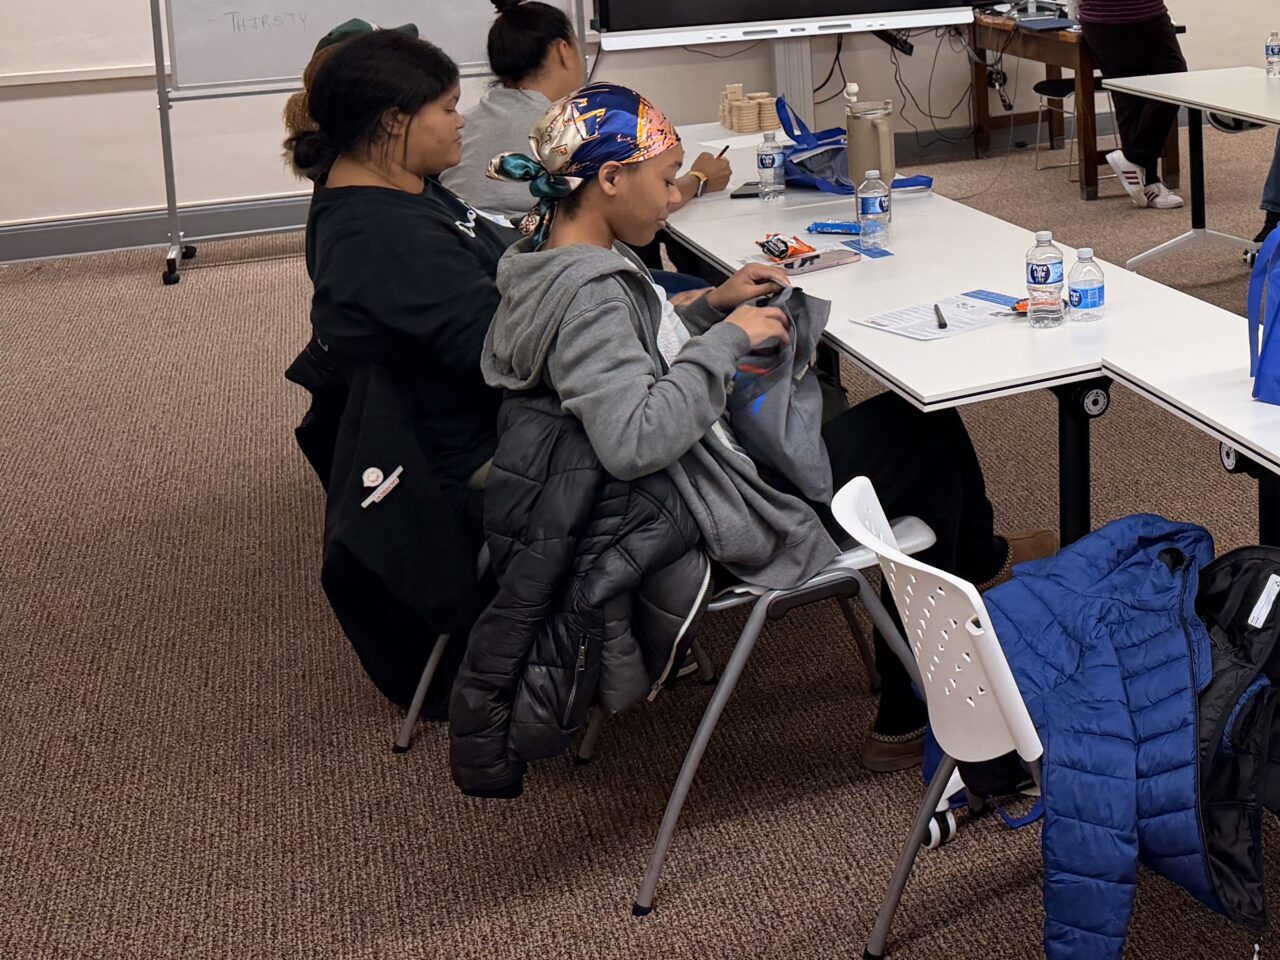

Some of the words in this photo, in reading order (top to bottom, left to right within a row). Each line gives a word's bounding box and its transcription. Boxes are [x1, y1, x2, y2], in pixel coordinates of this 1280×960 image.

[223, 11, 308, 33] THIRSTY
[1032, 264, 1048, 272] Pure
[1034, 271, 1046, 280] Life
